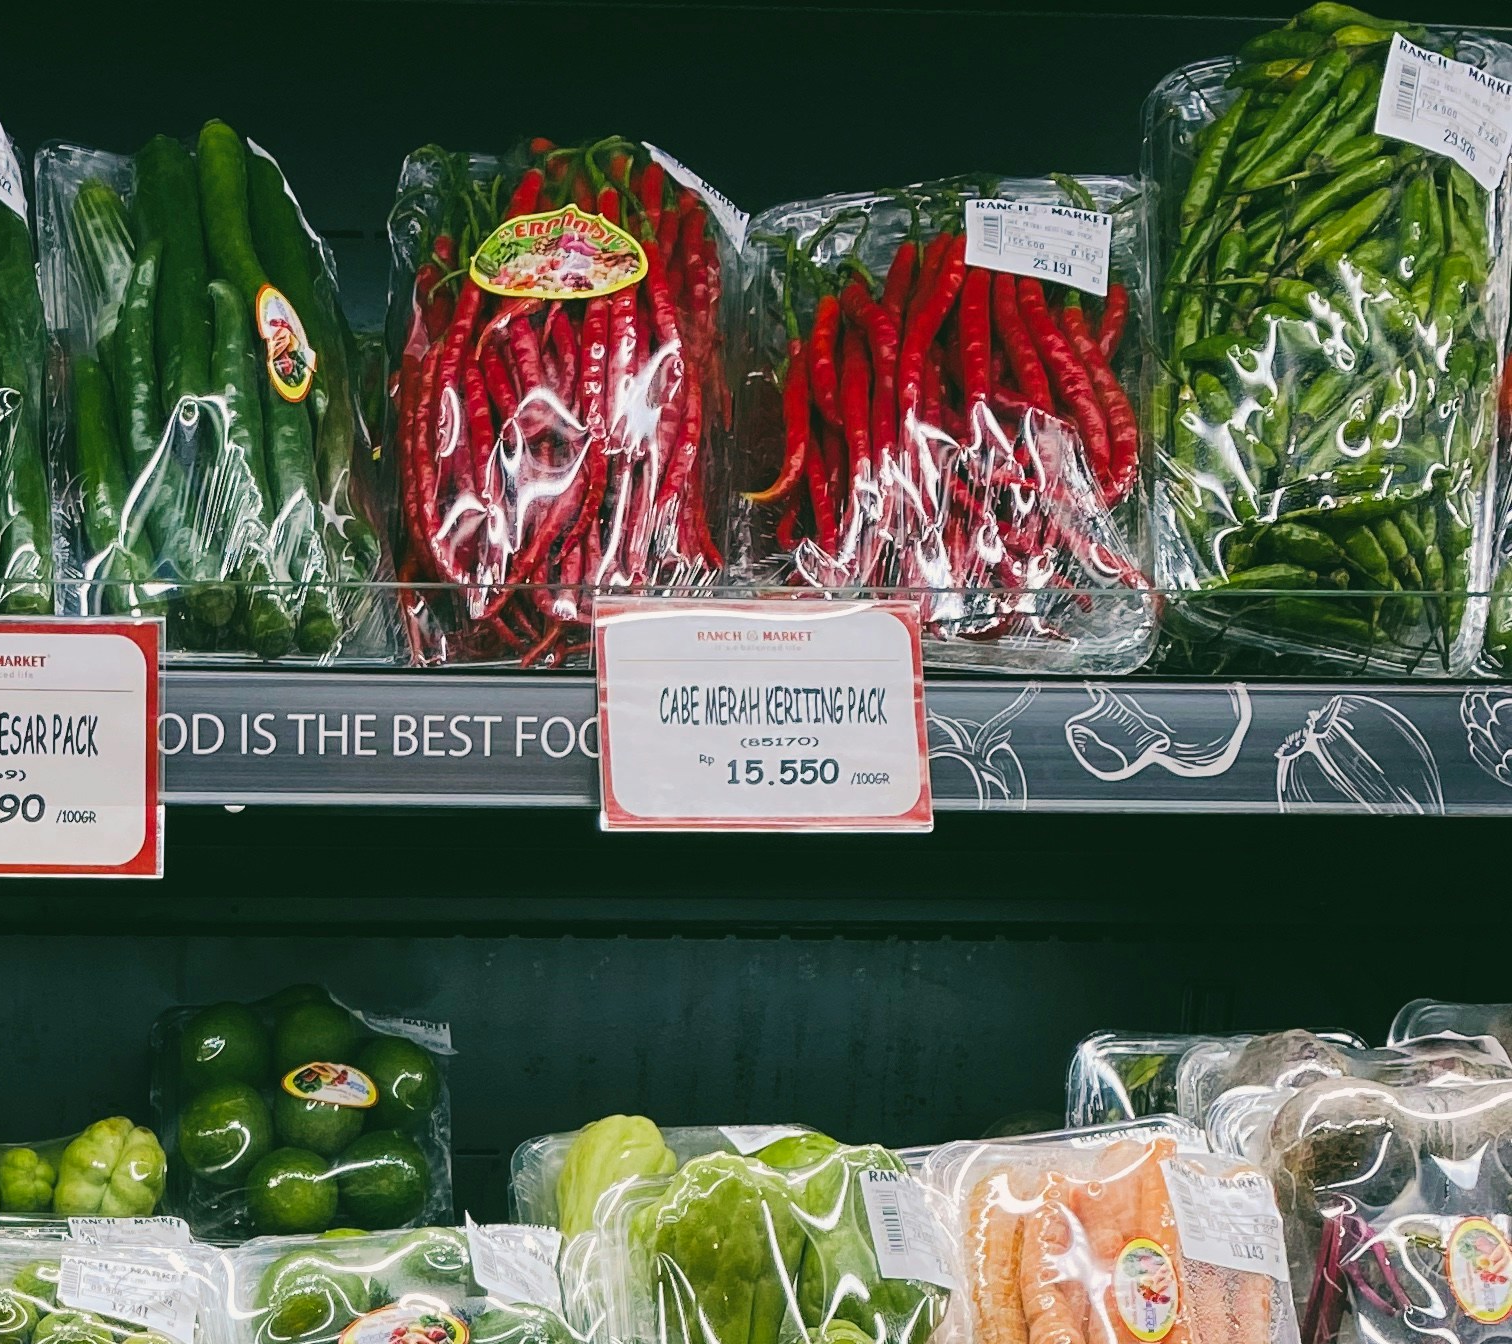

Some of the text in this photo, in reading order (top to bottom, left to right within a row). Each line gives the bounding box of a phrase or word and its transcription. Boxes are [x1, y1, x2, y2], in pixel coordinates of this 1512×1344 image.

[976, 202, 1108, 226] RANCH MARKET
[697, 631, 813, 642] RANCH MARKET
[660, 685, 888, 726] CABE MERAH KERITING PACK
[53, 714, 99, 757] PACK
[158, 713, 600, 759] OD IS THE BEST FOO
[740, 736, 819, 748] (85170)
[699, 754, 890, 786] Rp 15.550 /100GR
[56, 810, 97, 824] /100GR
